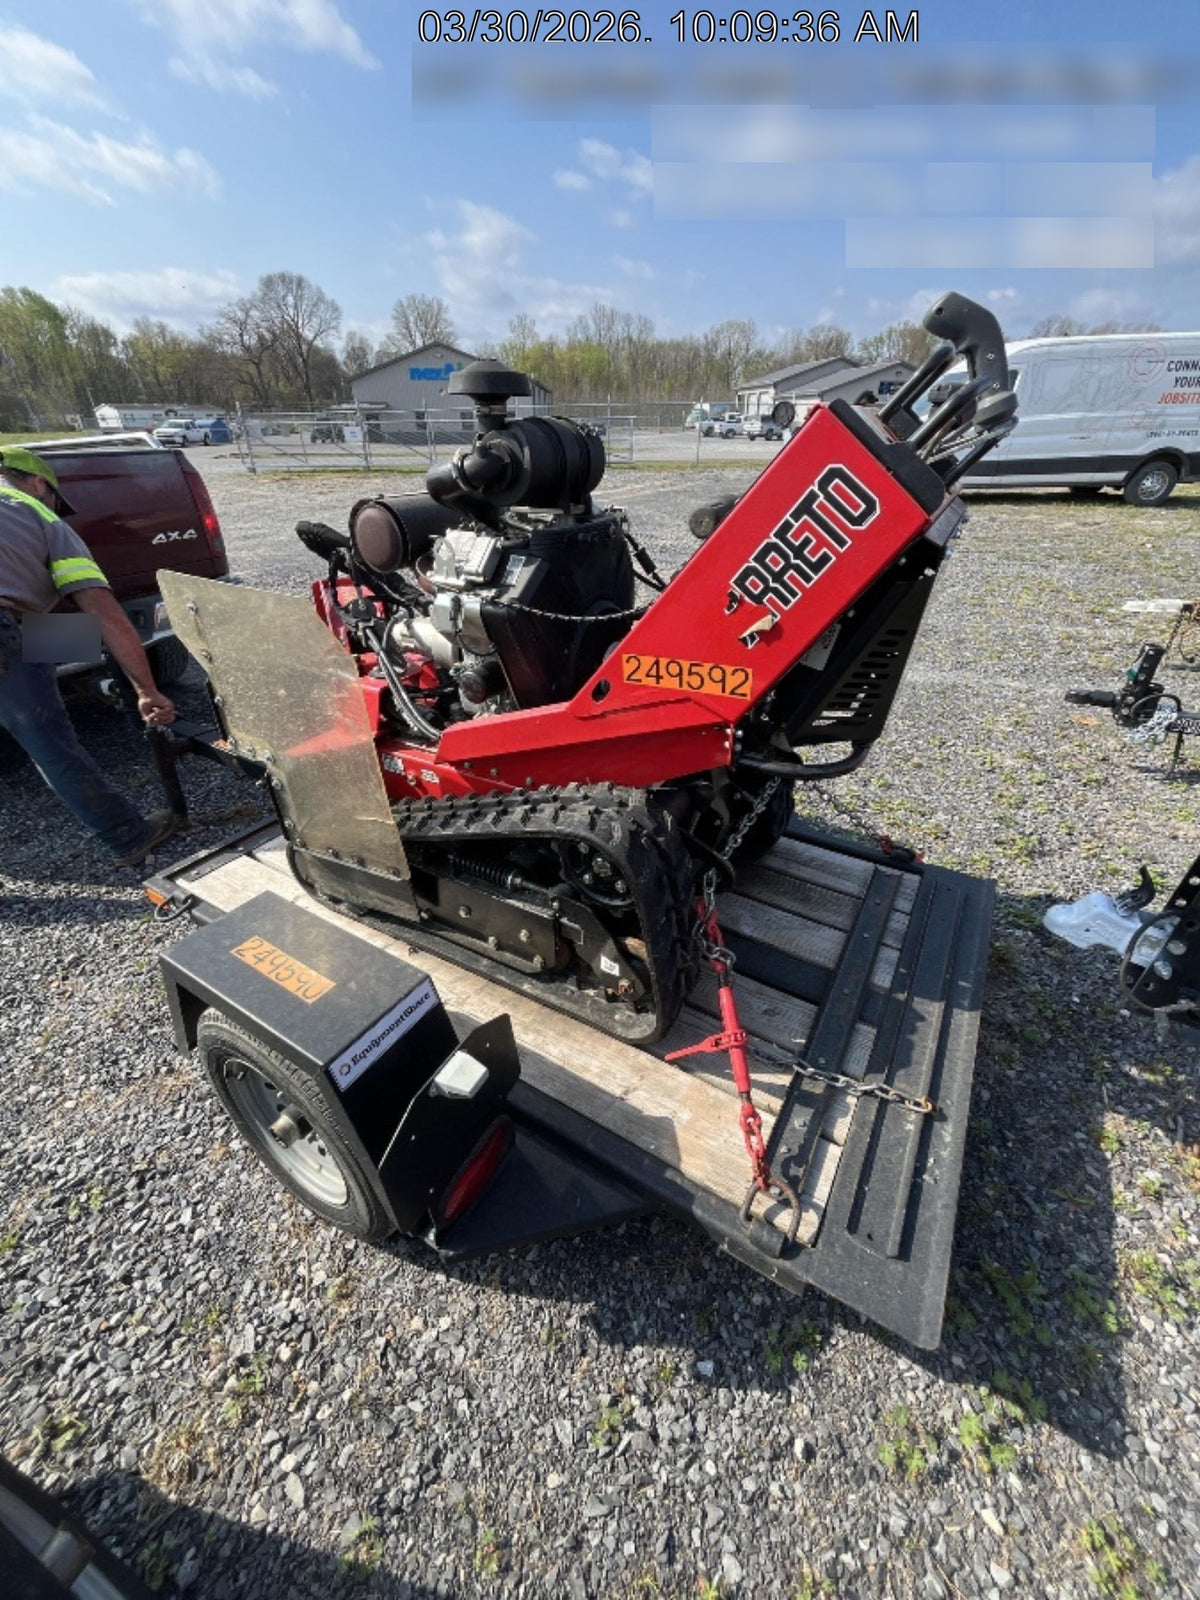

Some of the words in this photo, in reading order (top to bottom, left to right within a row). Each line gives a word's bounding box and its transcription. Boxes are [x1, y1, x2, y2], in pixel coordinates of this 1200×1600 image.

[1167, 361, 1200, 372] CONN
[724, 462, 881, 649] RRETO
[624, 654, 750, 697] 249592
[351, 991, 431, 1066] EquipmentShare
